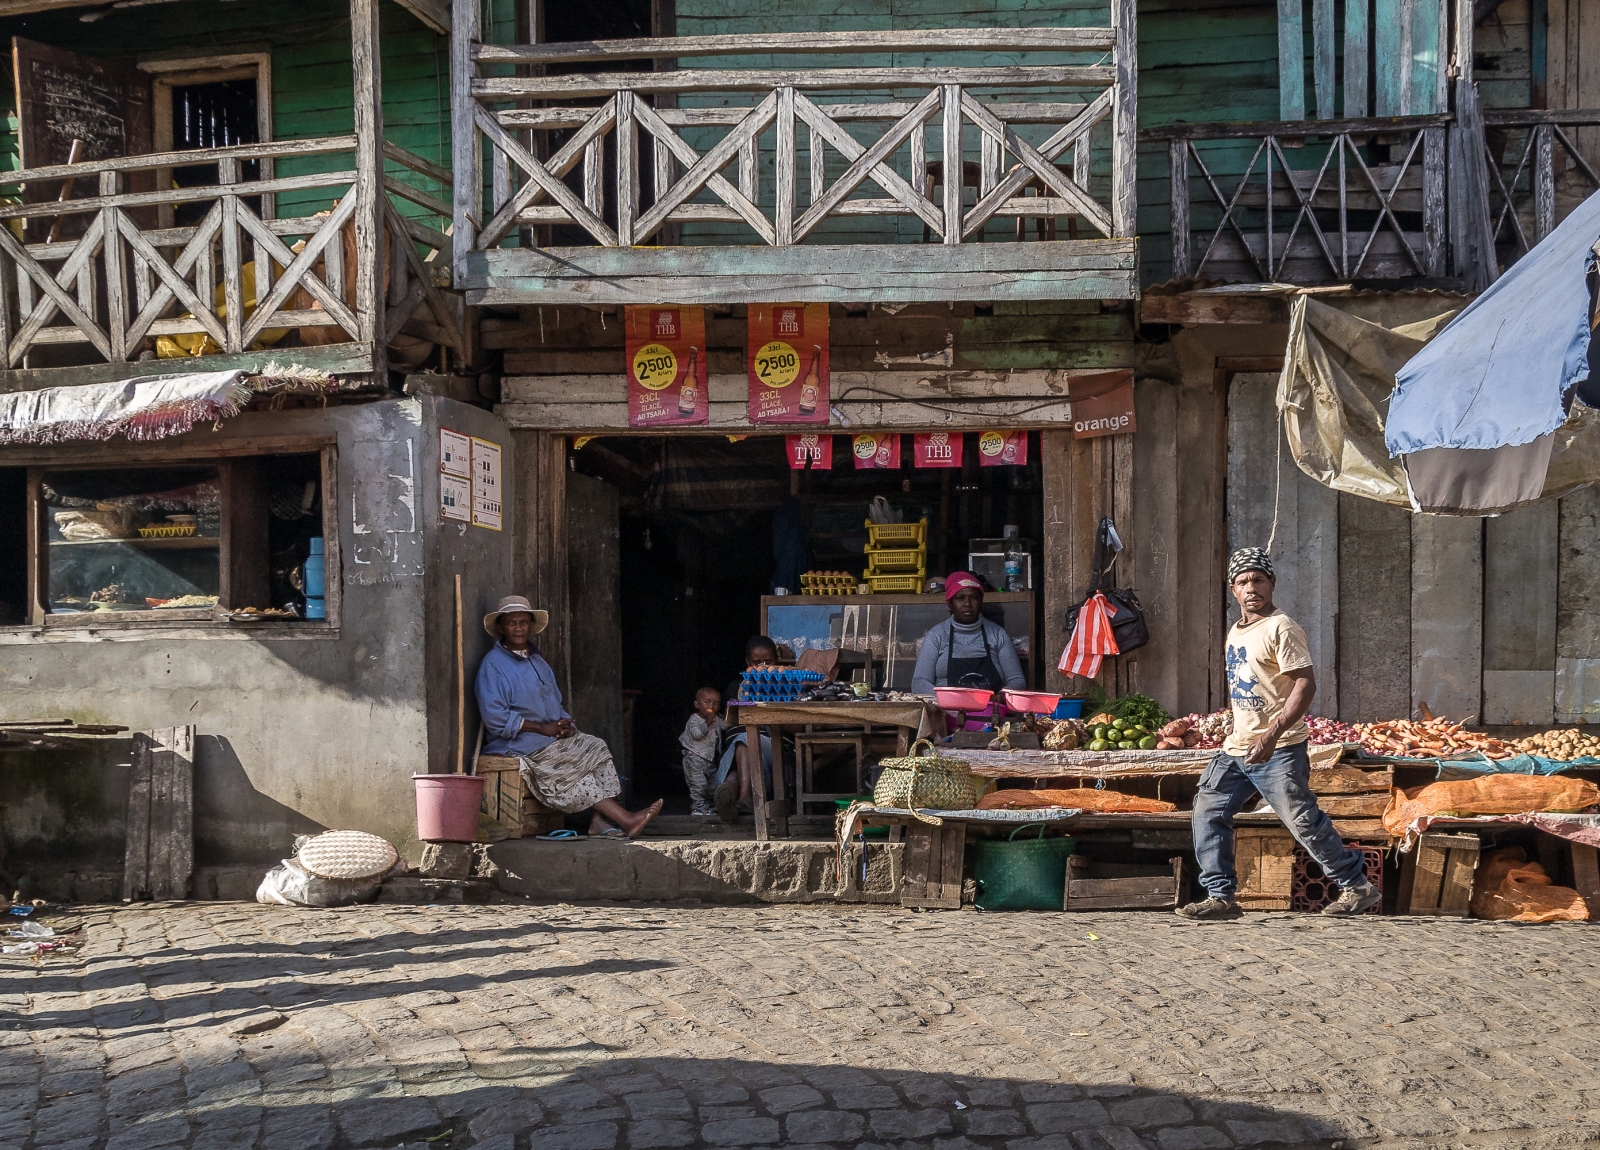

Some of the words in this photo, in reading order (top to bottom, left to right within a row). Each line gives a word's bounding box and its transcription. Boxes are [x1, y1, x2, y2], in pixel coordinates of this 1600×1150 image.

[656, 324, 676, 335] THB
[779, 321, 799, 332] THB
[637, 355, 673, 381] 2500
[759, 353, 796, 378] 2500
[640, 392, 661, 404] 33CL
[760, 390, 781, 402] 33CL
[1074, 415, 1129, 432] orange
[855, 440, 875, 454] 2500
[982, 437, 1002, 451] 2500
[926, 445, 952, 458] THB
